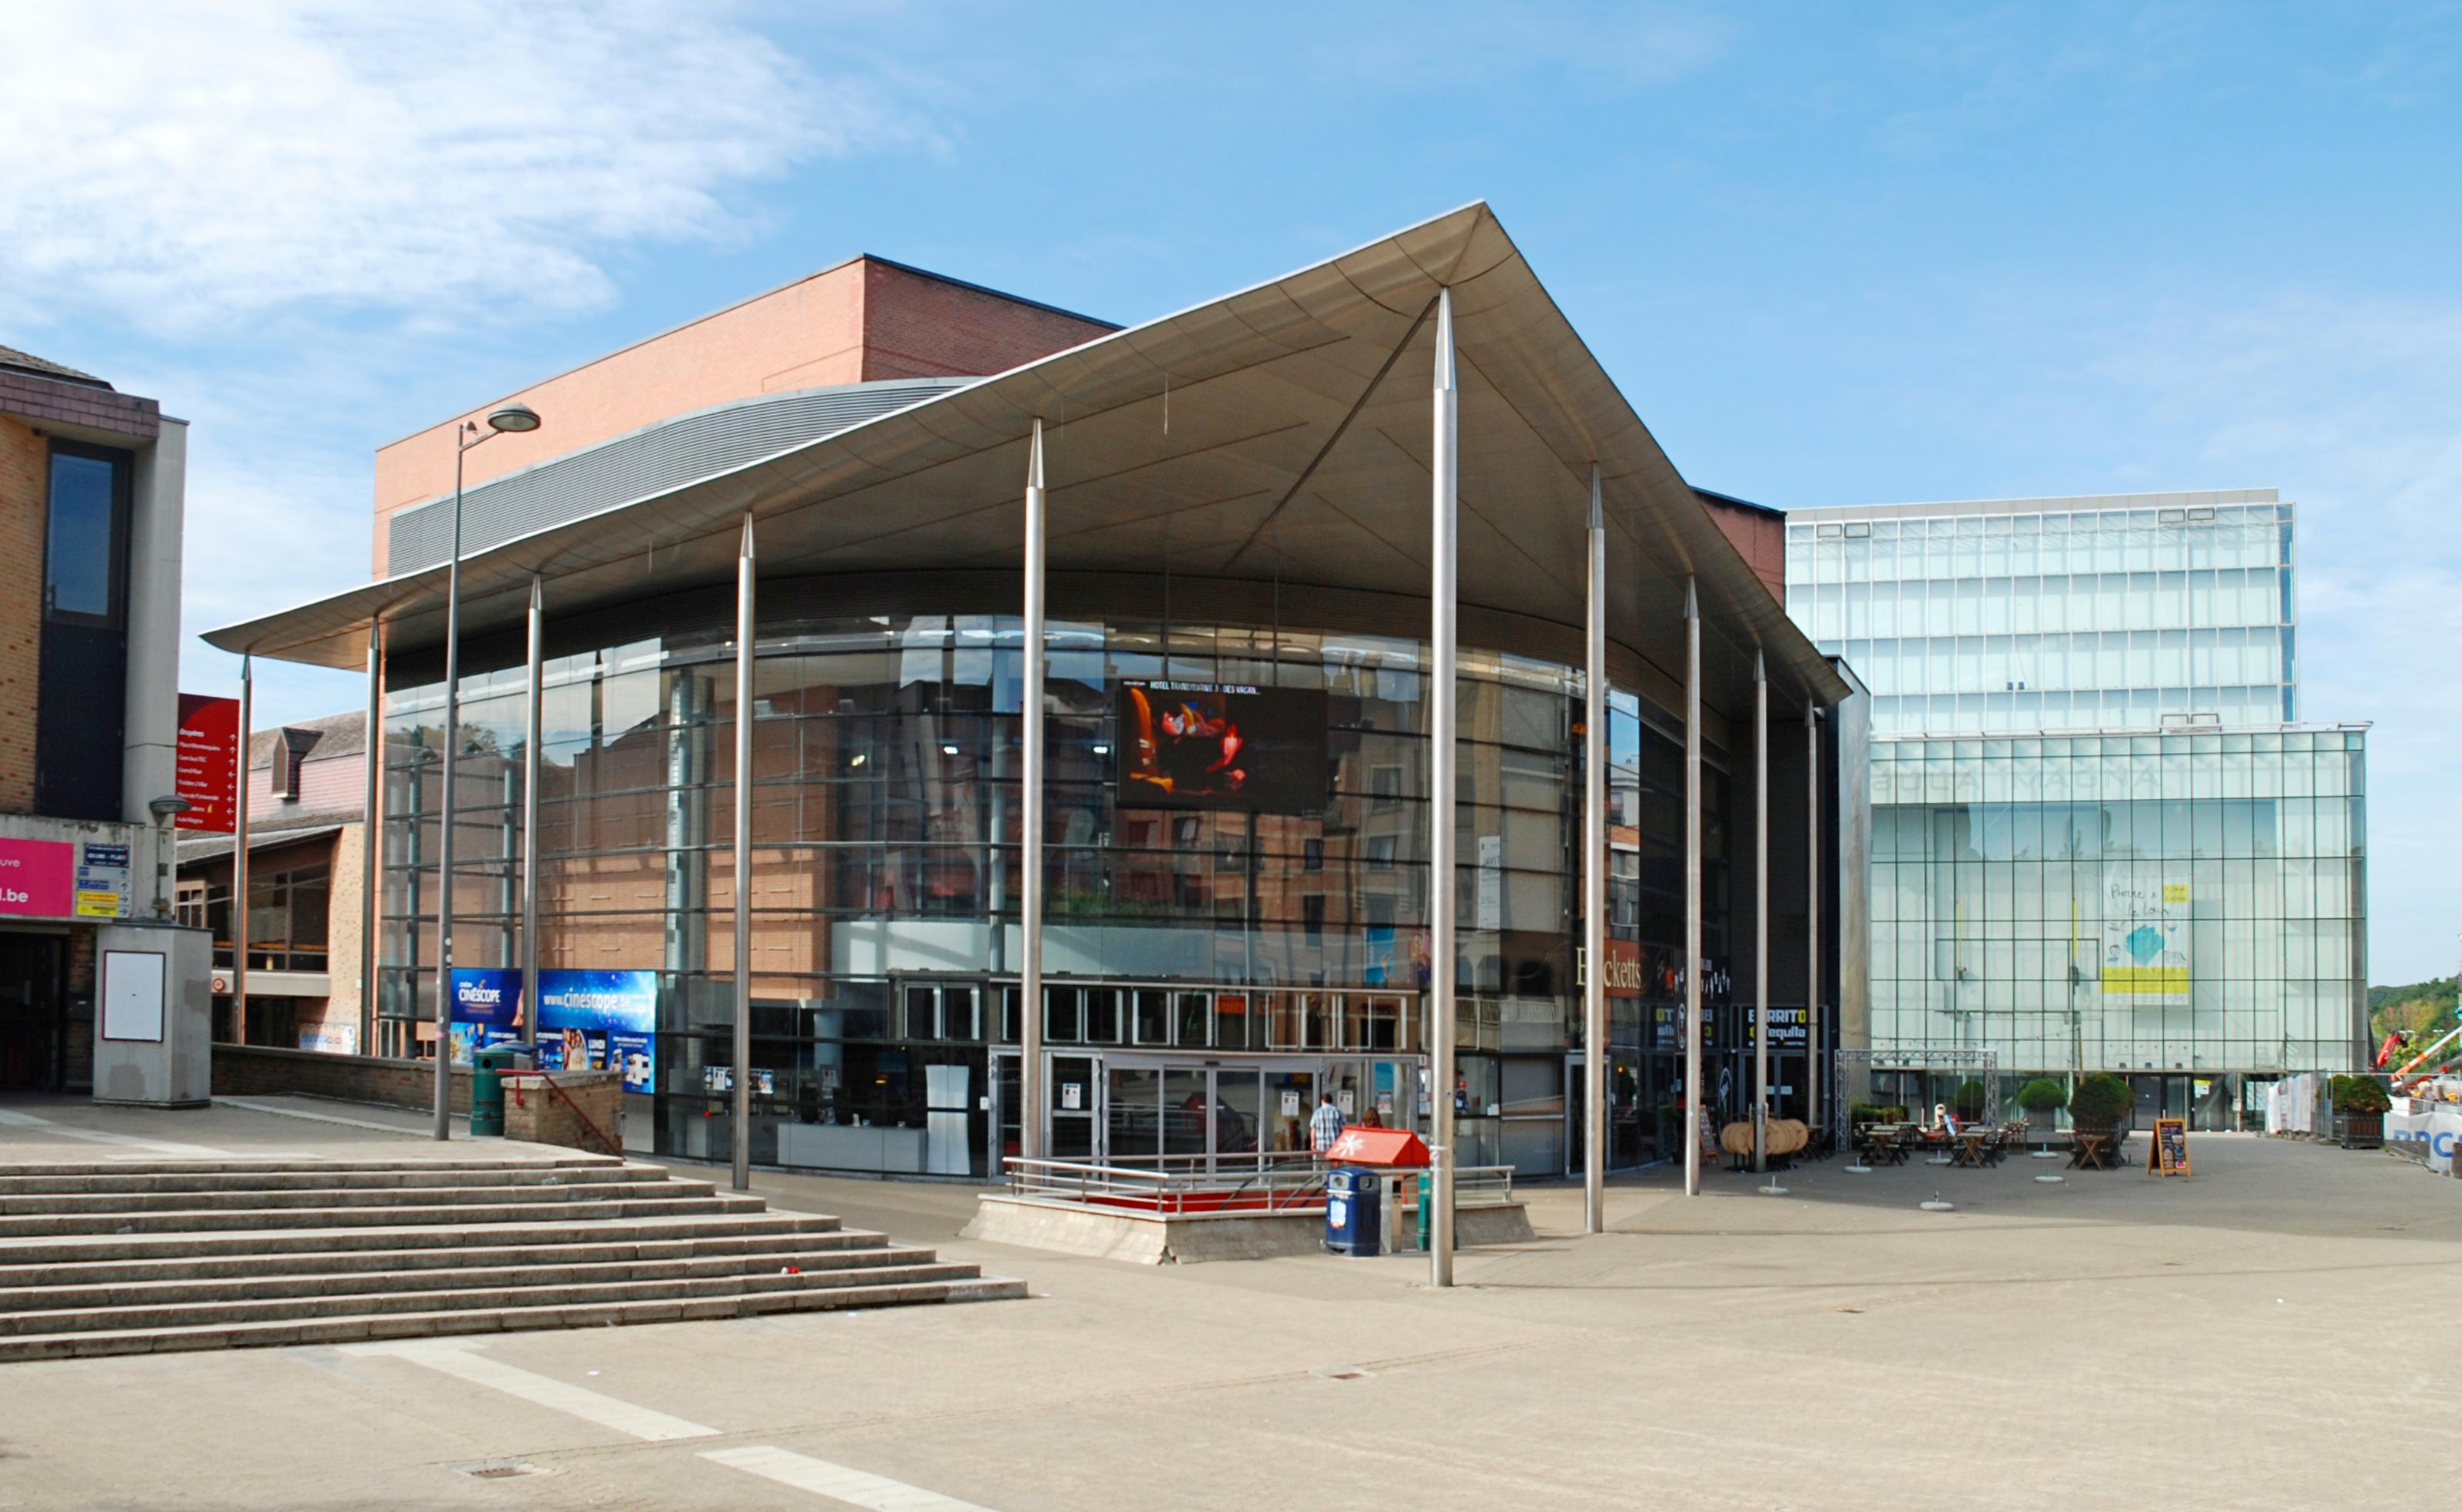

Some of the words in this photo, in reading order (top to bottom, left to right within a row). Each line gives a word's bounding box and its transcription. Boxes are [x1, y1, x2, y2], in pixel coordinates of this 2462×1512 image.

[1150, 681, 1170, 690] HOTEL
[2014, 769, 2159, 789] MAGNA
[1576, 947, 1641, 990] Bcketts
[1747, 1009, 1807, 1024] BRRITO
[1767, 1026, 1807, 1041] equila
